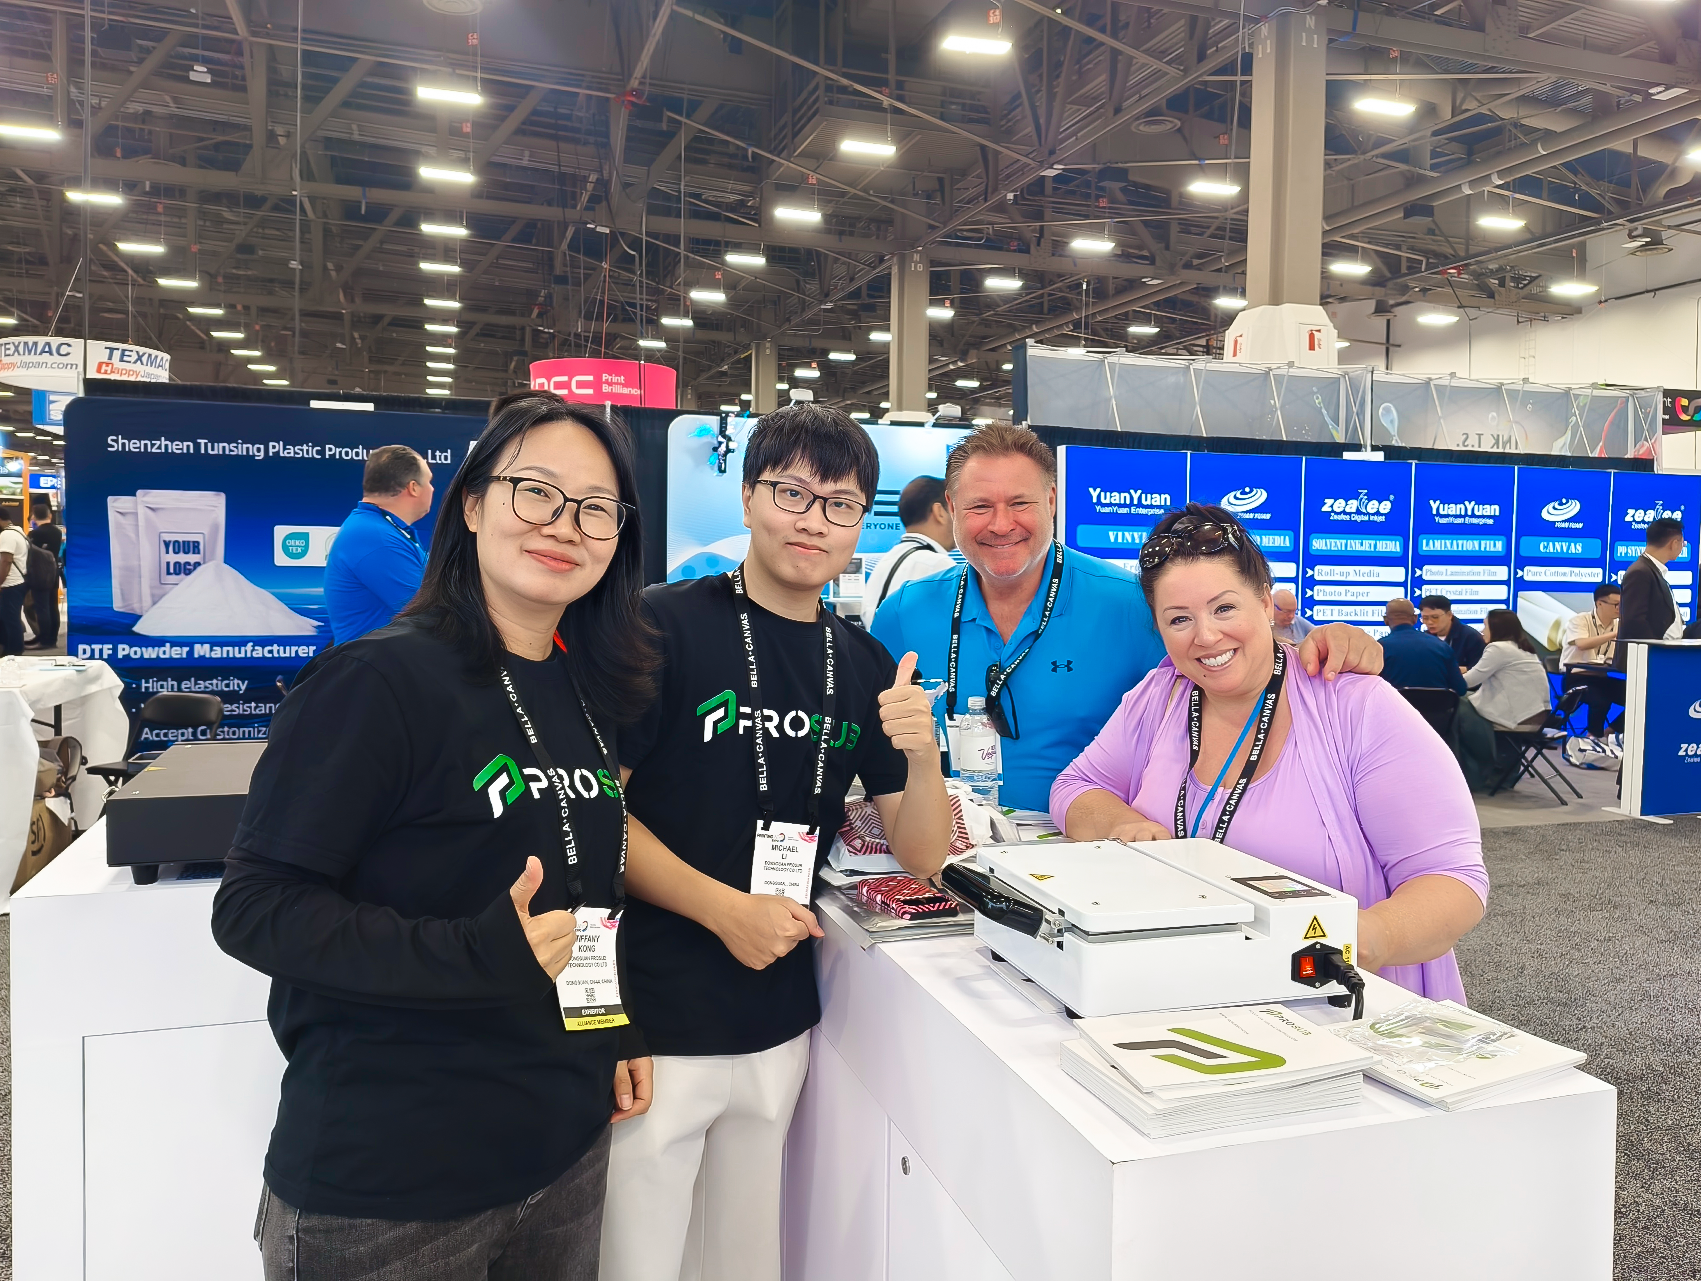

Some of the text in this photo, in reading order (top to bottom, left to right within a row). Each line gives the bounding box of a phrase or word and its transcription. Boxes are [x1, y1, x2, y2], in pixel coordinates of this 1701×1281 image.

[1306, 15, 1315, 29] N
[104, 346, 168, 371] TEXMAC
[602, 374, 625, 383] Print
[107, 434, 194, 454] Shenzhen
[197, 439, 265, 459] Tunsing
[268, 441, 321, 459] Plastic
[325, 444, 372, 461] Produ
[1088, 488, 1171, 506] YuanYuan
[1095, 505, 1165, 515] YuanYuan Enterprise
[1429, 500, 1500, 515] YuanYuan
[163, 540, 201, 555] YOUR
[1261, 536, 1290, 547] MEDIA
[1312, 538, 1401, 552] SOLVENT INKJET MEDIA
[1422, 539, 1503, 552] LAMINATION FILM
[1540, 542, 1583, 554] CANVAS
[1317, 568, 1380, 579] Roll-up Media
[1425, 568, 1497, 577] Photo Lamination Film
[1526, 569, 1543, 577] Pure
[1316, 588, 1370, 599] Photo Paper
[1464, 588, 1479, 596] Film
[1316, 608, 1335, 617] PET
[1337, 608, 1369, 617] Backlit
[78, 642, 317, 659] DTF Powder Manufacturer
[141, 677, 249, 693] High elasticity
[141, 728, 194, 744] Accept
[771, 844, 799, 853] MICHAEL
[578, 944, 596, 953] KONG
